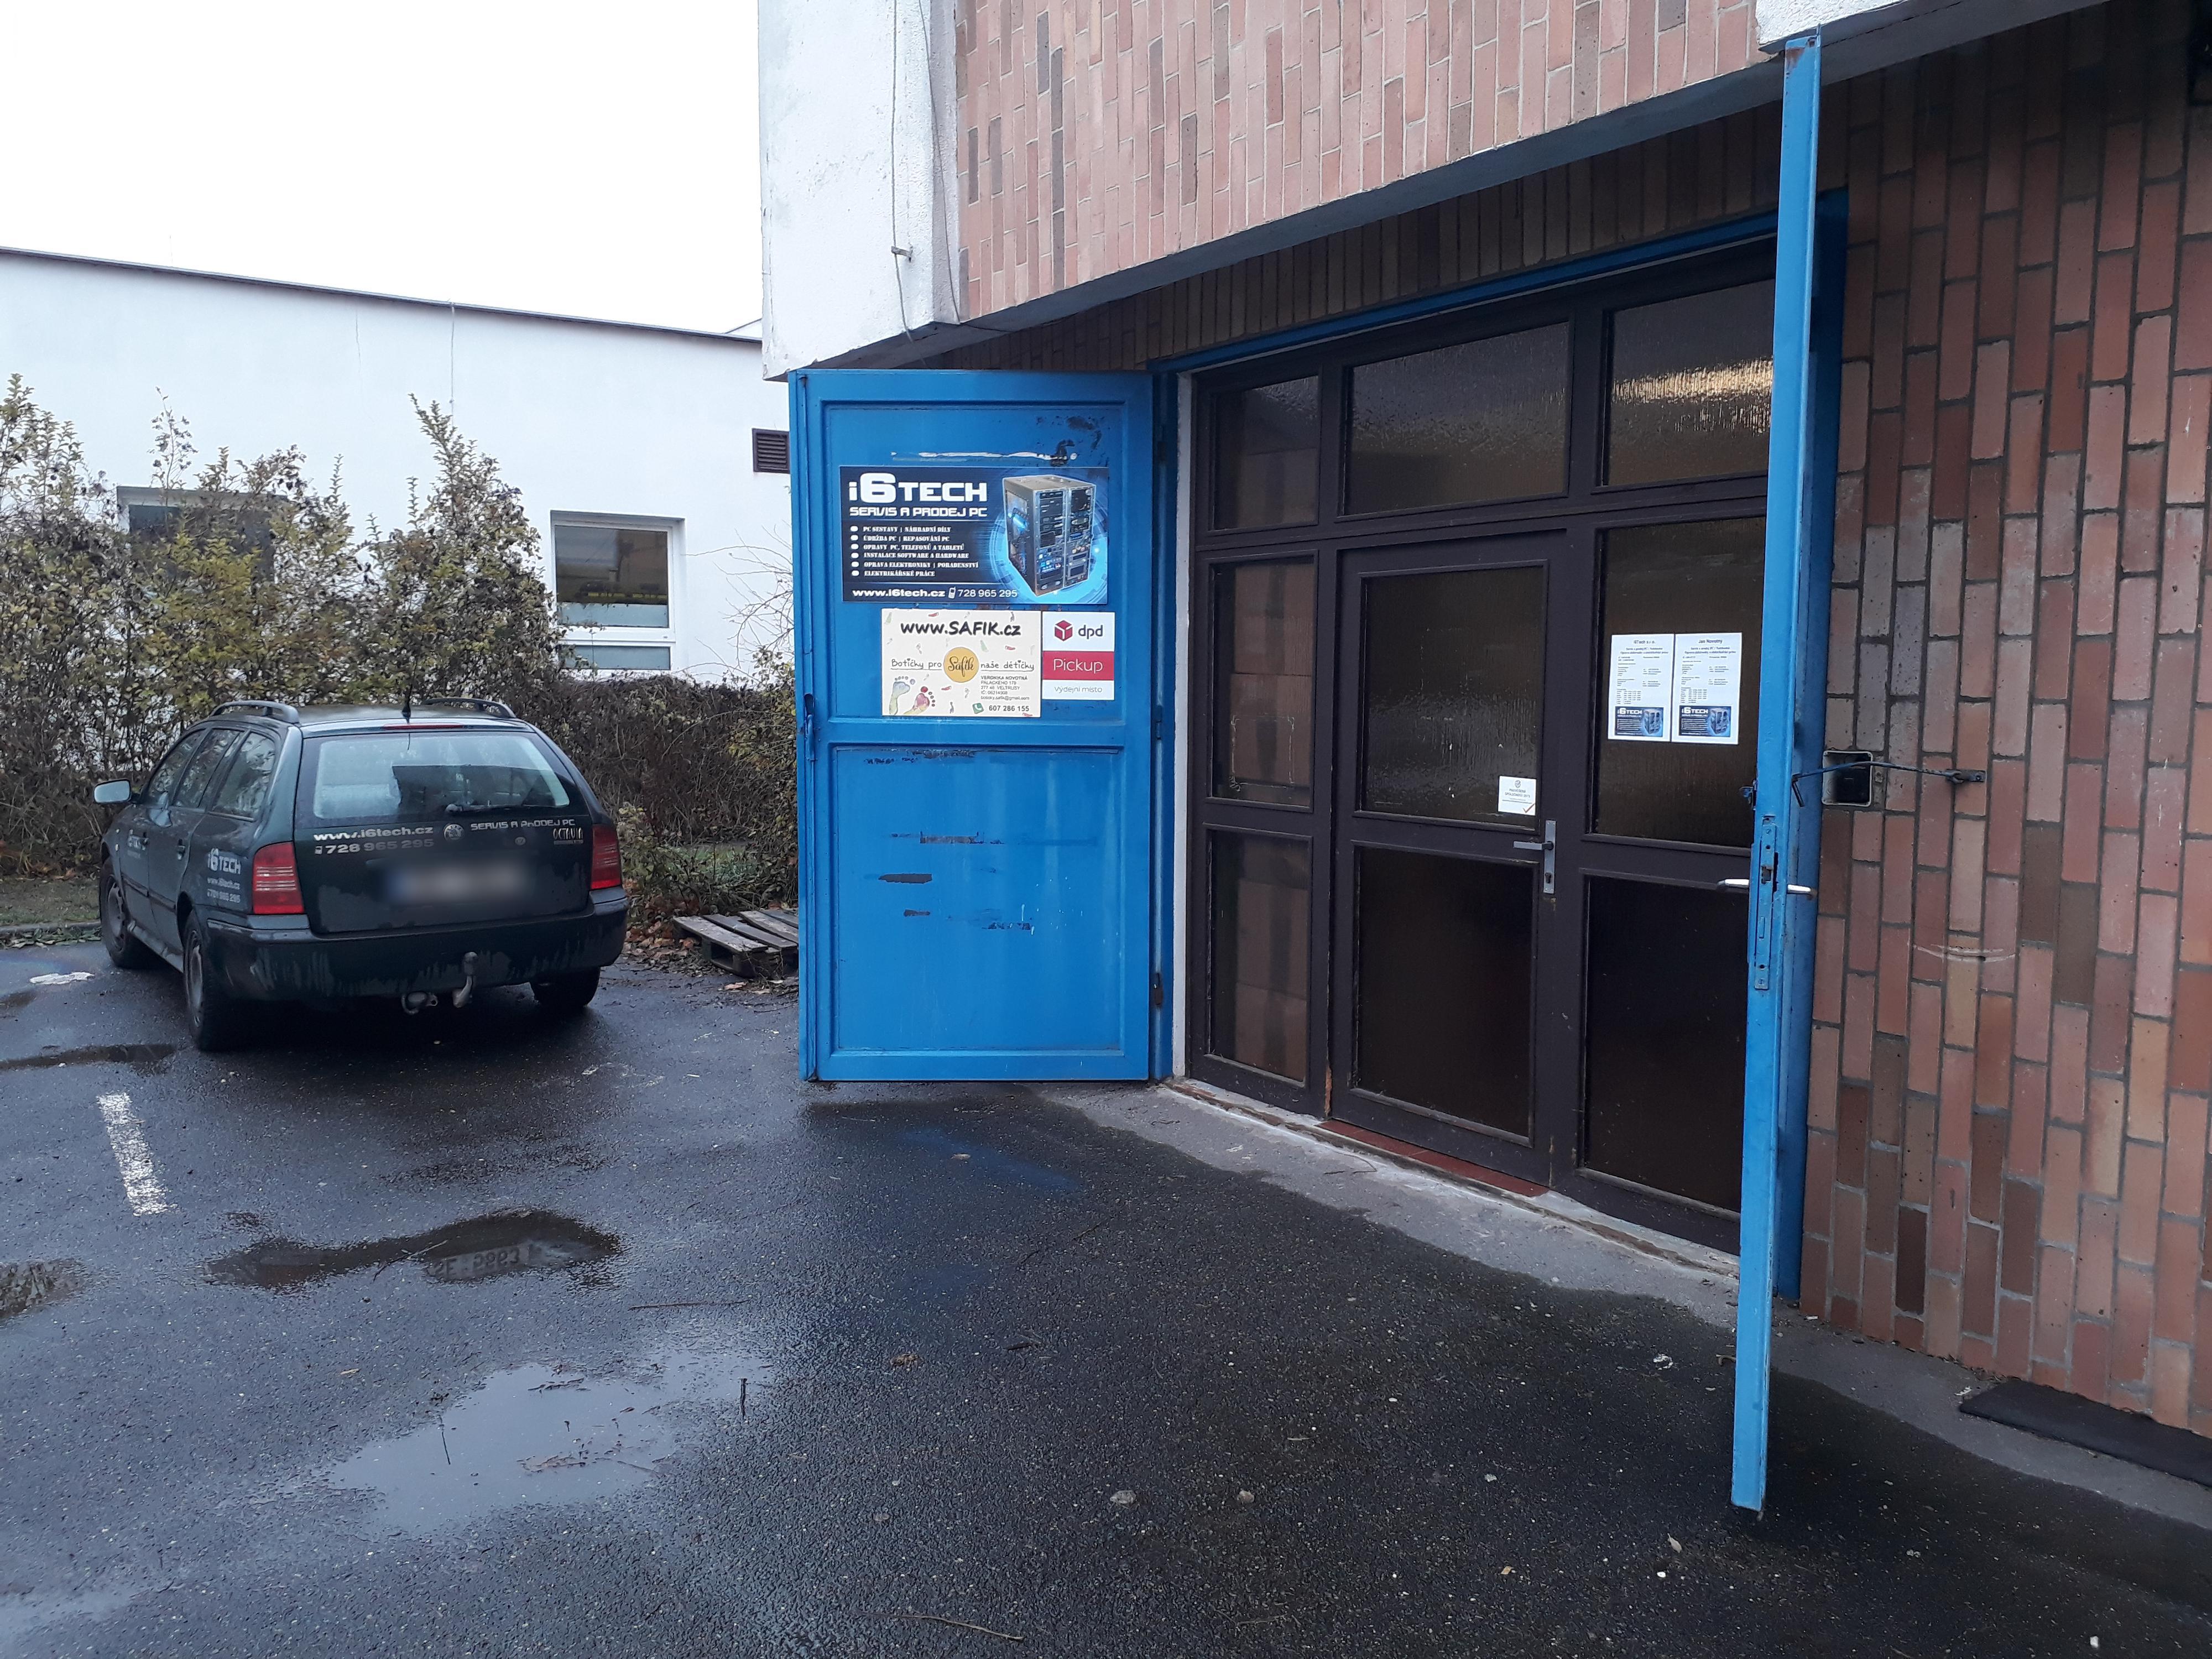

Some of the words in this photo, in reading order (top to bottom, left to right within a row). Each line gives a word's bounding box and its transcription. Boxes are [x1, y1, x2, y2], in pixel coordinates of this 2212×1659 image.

[848, 472, 988, 503] i6TECH
[849, 507, 898, 517] SERVIS
[900, 507, 910, 517] A
[912, 507, 966, 517] PRODEJ
[968, 507, 988, 517] PC
[852, 588, 946, 598] www.i6tech.cz
[958, 589, 976, 598] 728
[978, 589, 997, 598] 965
[999, 589, 1018, 598] 295
[900, 620, 1021, 636] www.SAFIK.cz
[1078, 624, 1103, 640] dpd
[928, 661, 942, 670] pro
[980, 660, 999, 669] naše
[1053, 658, 1103, 674] Pickup
[470, 821, 509, 831] SERVIS
[510, 820, 519, 828] A
[553, 827, 583, 839] OCTAVIA
[325, 843, 361, 854] 728
[363, 841, 398, 852] 965
[401, 838, 435, 849] 295
